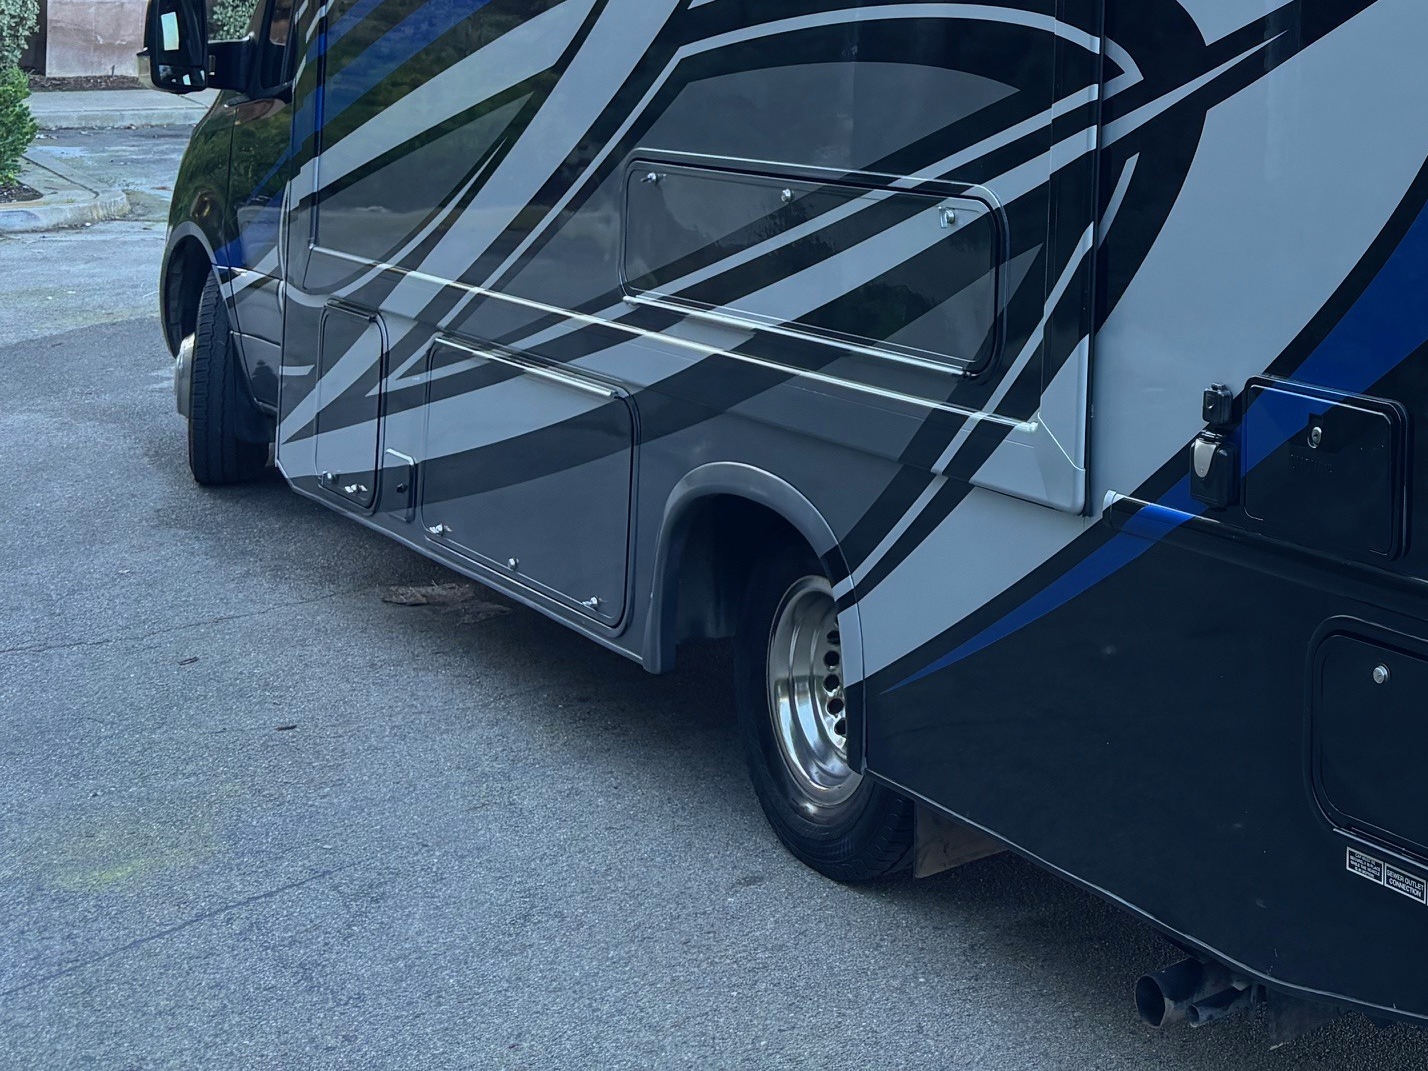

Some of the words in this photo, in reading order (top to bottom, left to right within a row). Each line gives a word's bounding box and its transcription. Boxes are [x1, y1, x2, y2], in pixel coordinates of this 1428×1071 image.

[1386, 870, 1404, 882] SEWER
[1404, 877, 1424, 890] OUTLET
[1388, 878, 1421, 897] CONNECTION
